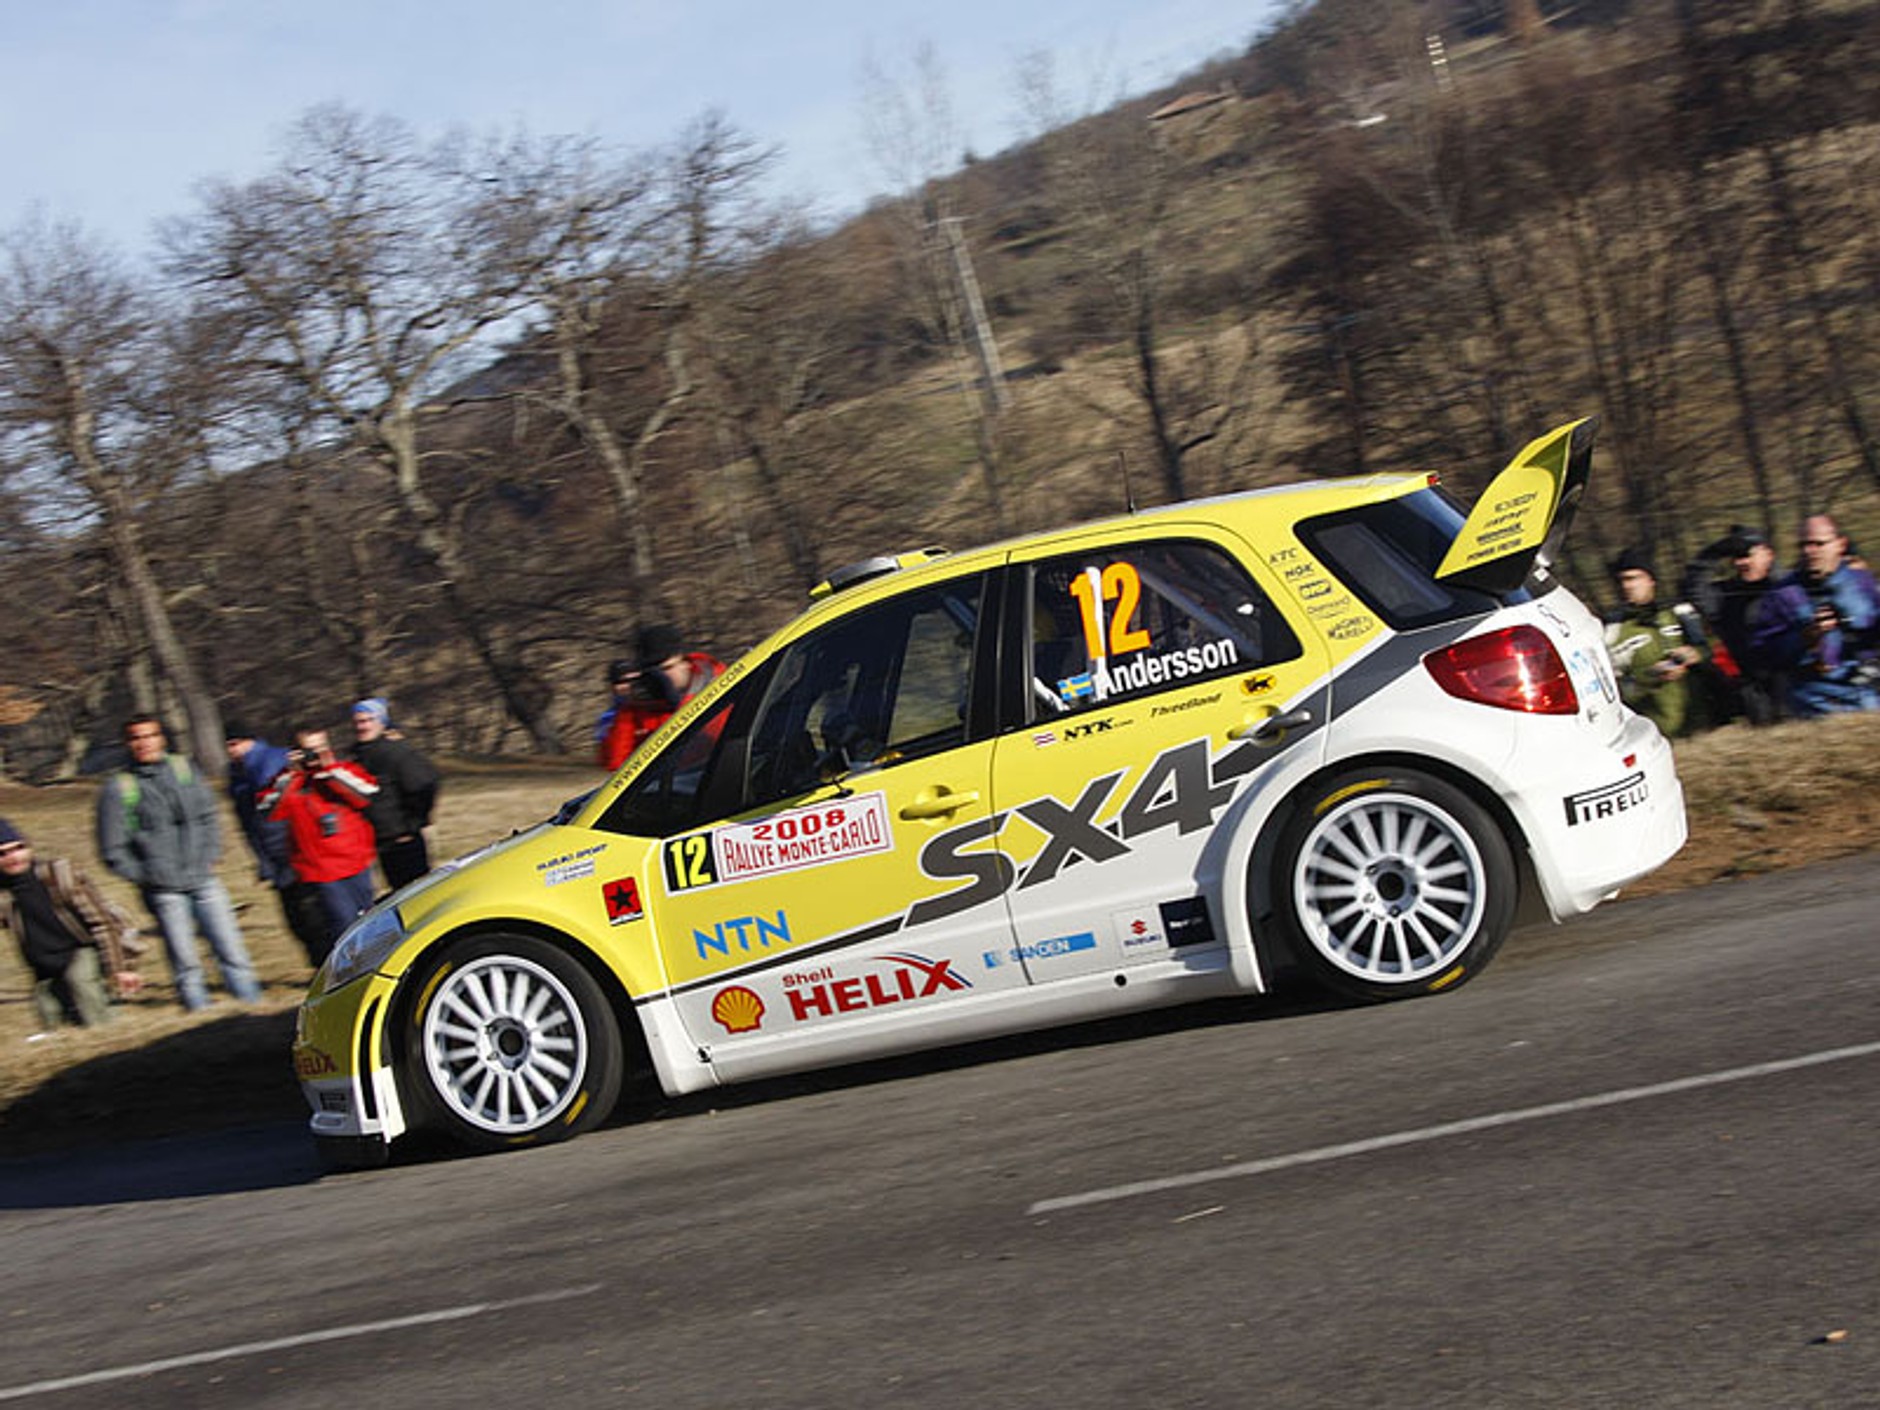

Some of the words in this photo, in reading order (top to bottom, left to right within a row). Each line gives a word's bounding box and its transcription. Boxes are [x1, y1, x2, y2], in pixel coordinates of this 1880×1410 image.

[1069, 562, 1150, 660] 12
[1094, 638, 1238, 698] Andersson
[753, 809, 846, 841] 2008
[1563, 771, 1649, 826] PIRELLI
[723, 838, 775, 874] RALLYE
[777, 808, 881, 863] MONTE-CARLO
[904, 738, 1240, 926] SX4
[670, 836, 712, 889] 12
[693, 910, 792, 960] NTN
[783, 966, 834, 988] Shell
[784, 958, 966, 1021] HELIX
